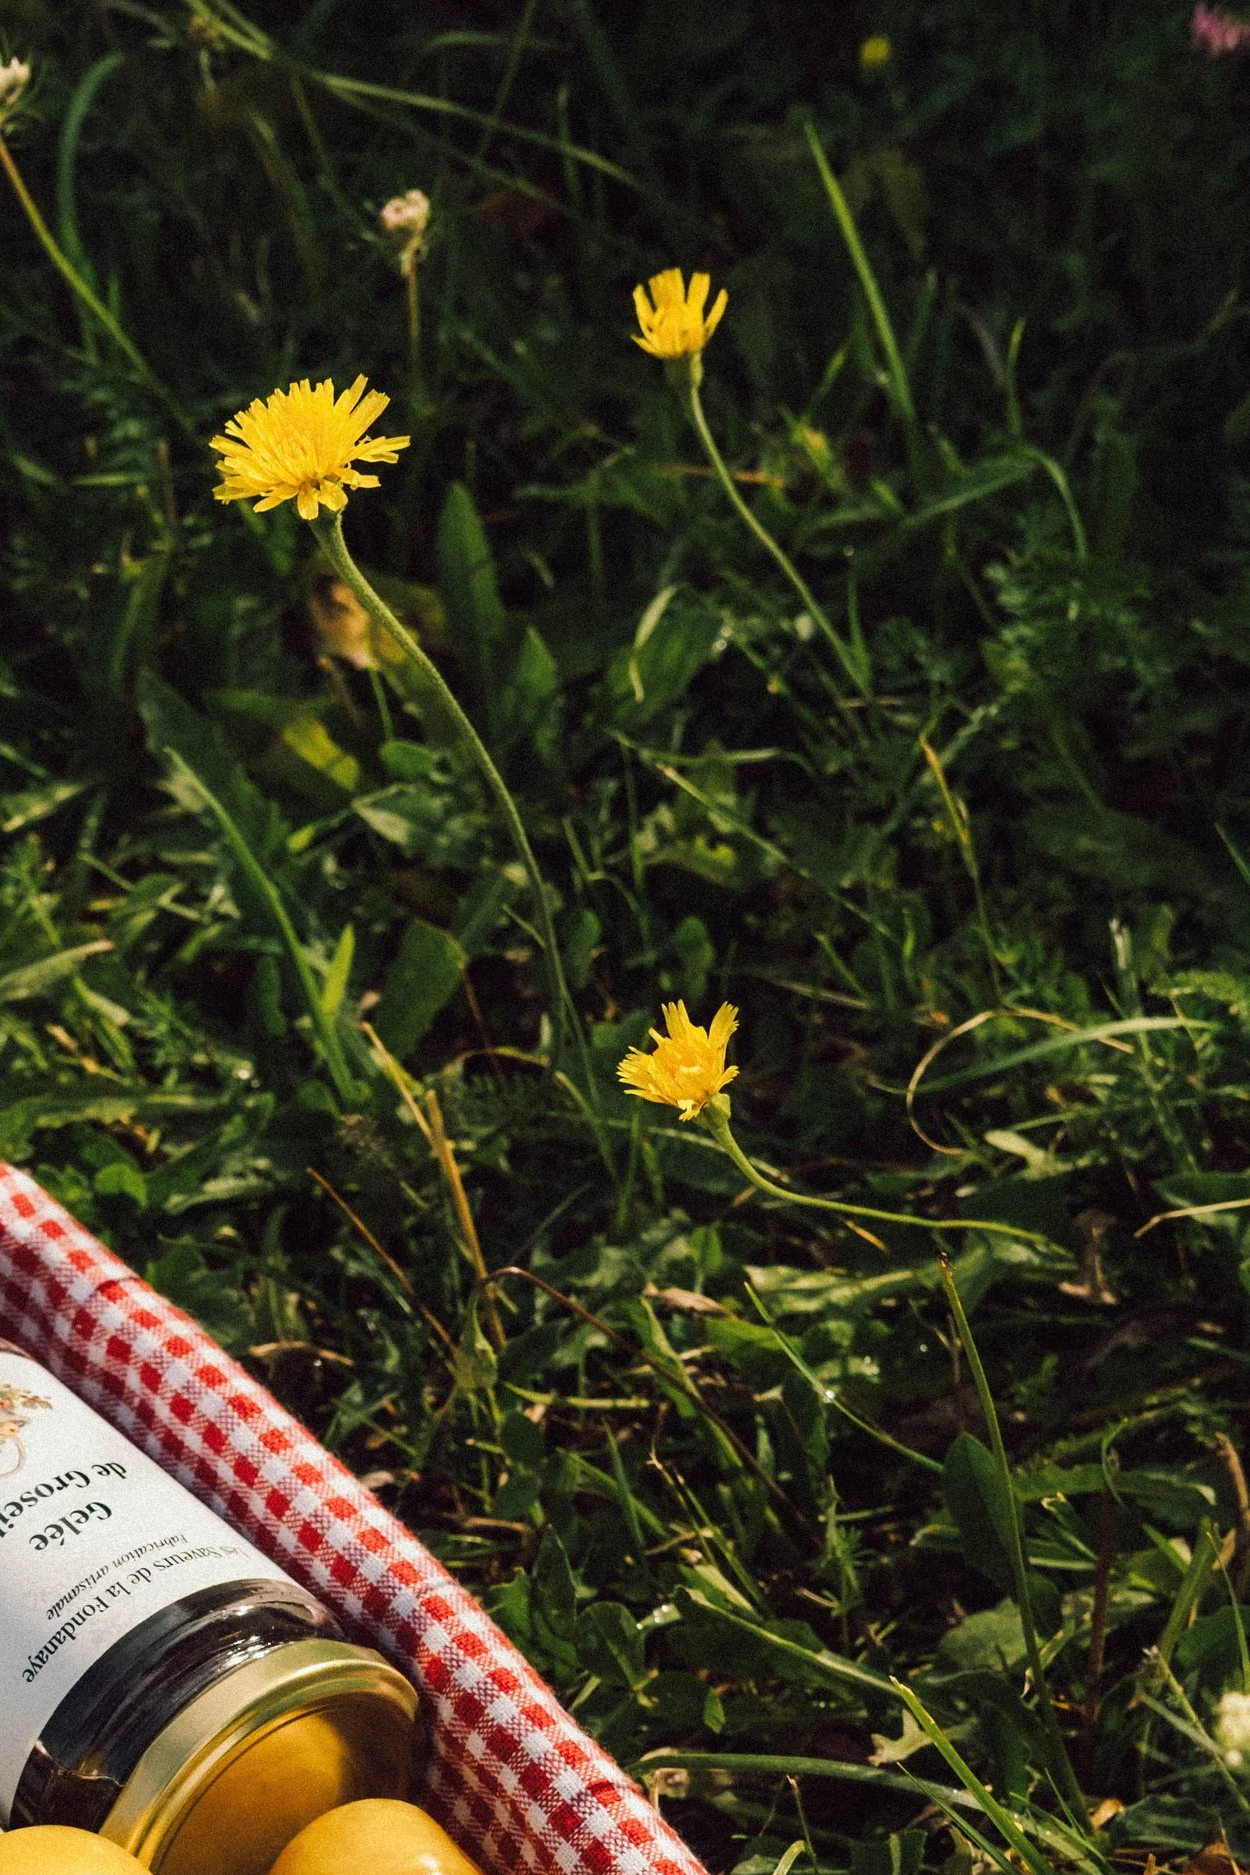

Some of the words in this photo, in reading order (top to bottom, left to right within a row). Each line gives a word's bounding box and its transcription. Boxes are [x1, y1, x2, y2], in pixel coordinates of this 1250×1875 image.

[92, 1462, 128, 1480] de
[29, 1501, 112, 1551] Gelée
[112, 1534, 188, 1570] Fabrication
[153, 1545, 223, 1572] Saveurs
[106, 1582, 131, 1599] la
[127, 1567, 152, 1586] de
[46, 1567, 110, 1621] artisanale
[22, 1597, 110, 1683] Fondanaye
